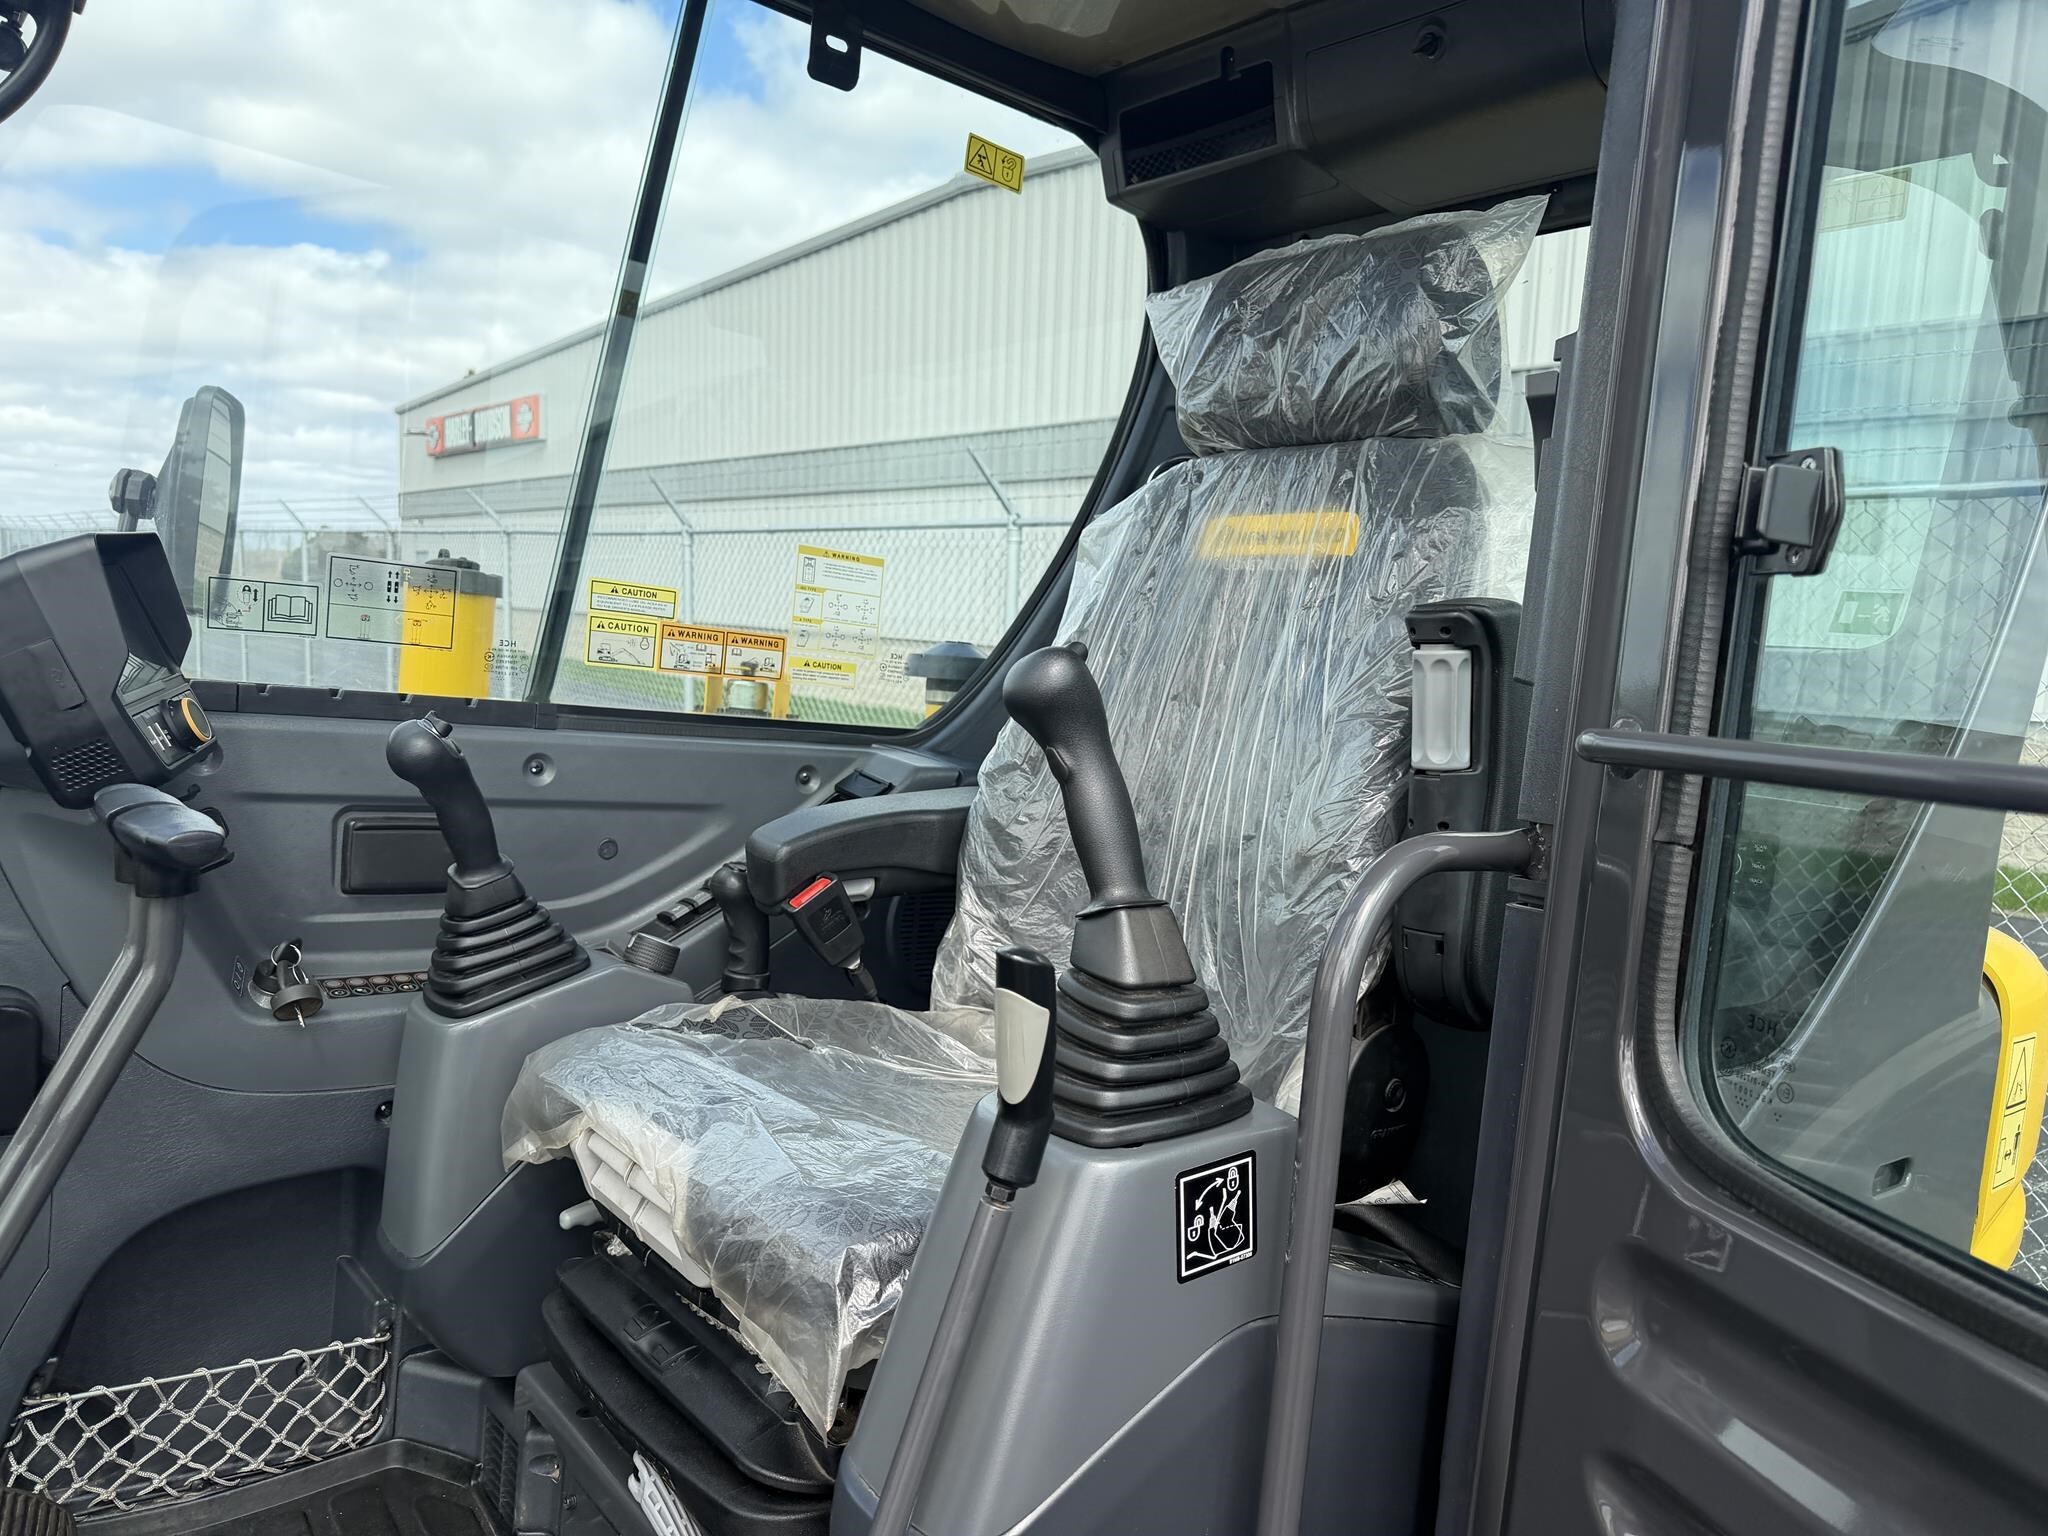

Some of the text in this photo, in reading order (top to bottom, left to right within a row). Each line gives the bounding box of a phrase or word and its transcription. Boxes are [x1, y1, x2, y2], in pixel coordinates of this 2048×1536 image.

[832, 552, 860, 563] WARNING
[621, 587, 658, 599] CAUTION
[607, 622, 650, 634] CAUTION
[677, 629, 719, 642] WARNING
[740, 637, 780, 649] WARNING
[812, 661, 842, 671] CAUTION
